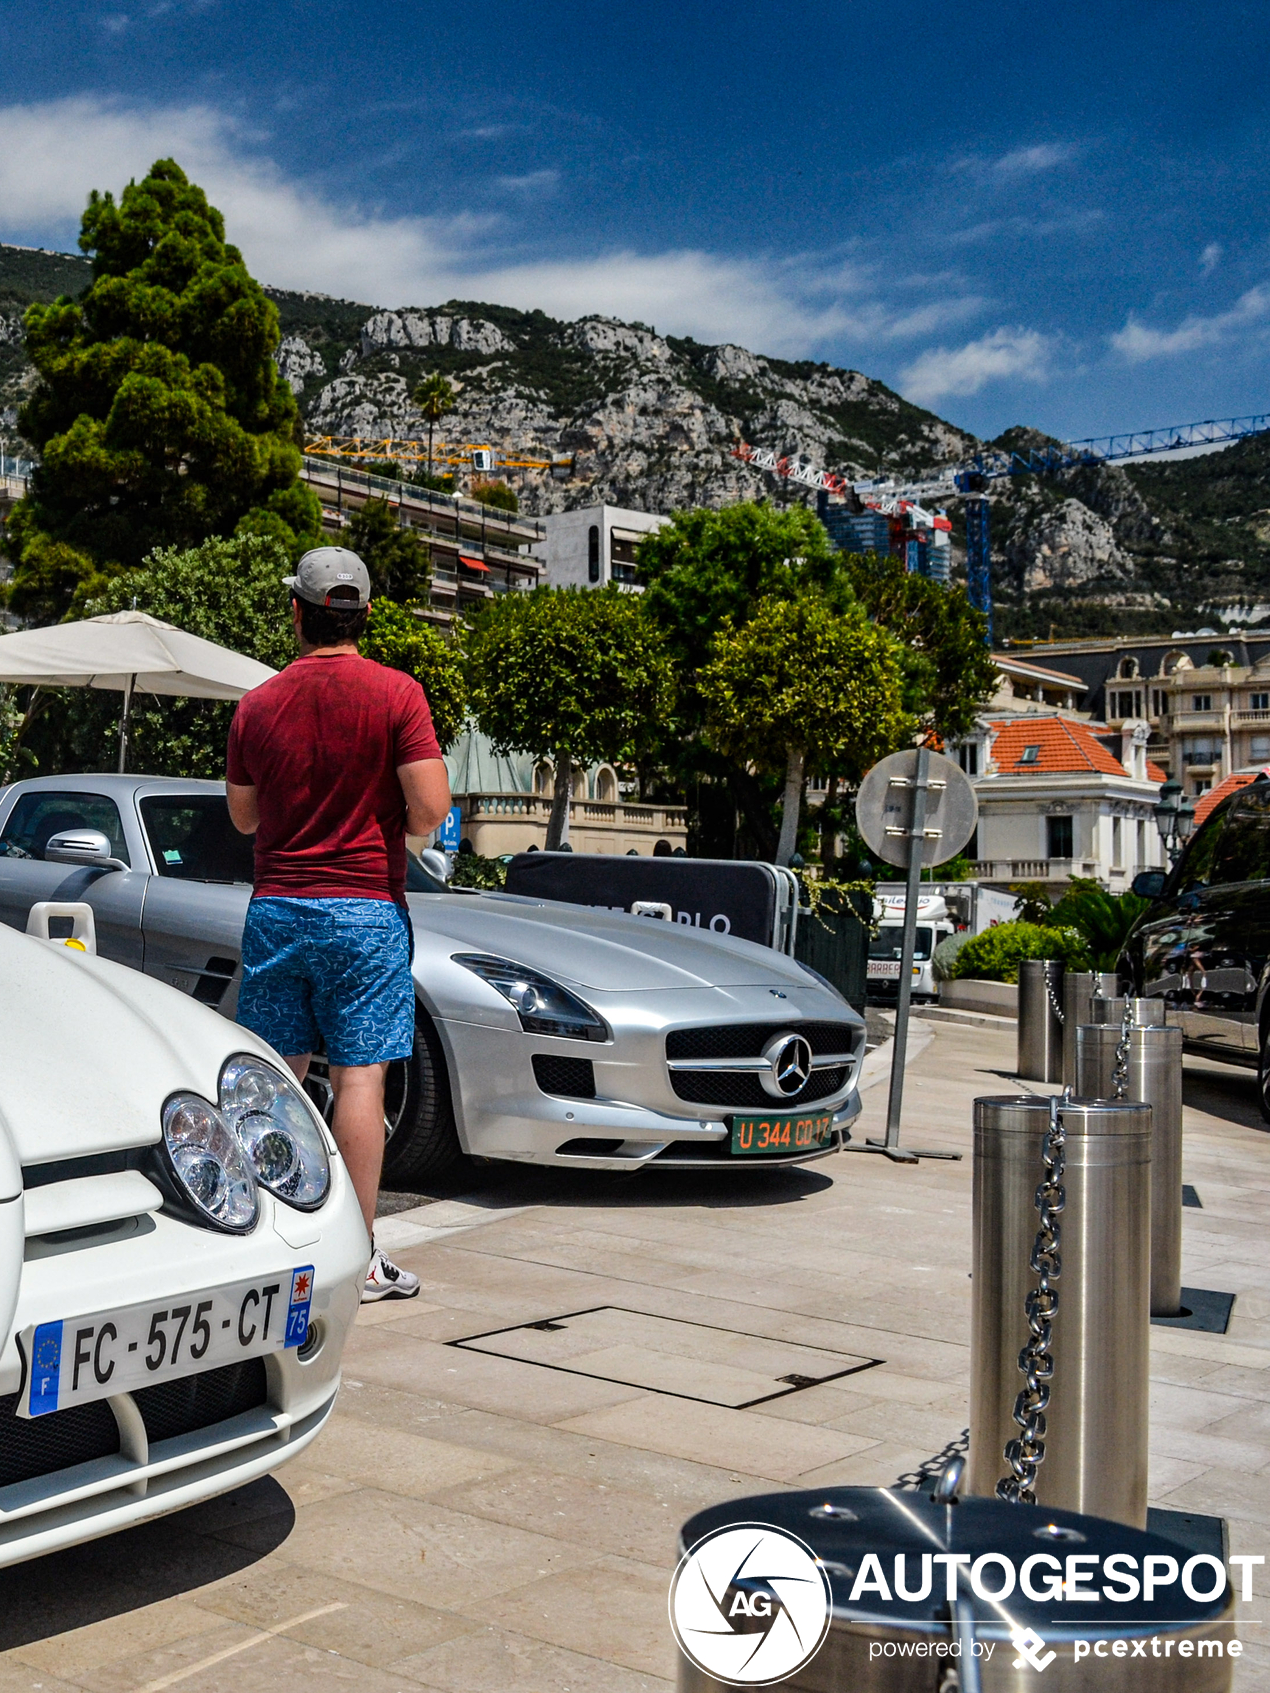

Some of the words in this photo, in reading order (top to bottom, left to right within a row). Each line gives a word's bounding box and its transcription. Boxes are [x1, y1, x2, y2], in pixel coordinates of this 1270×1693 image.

[740, 1123, 754, 1149] U
[758, 1121, 791, 1148] 344
[795, 1120, 813, 1146] CD
[290, 1309, 307, 1336] 75
[40, 1377, 50, 1396] F
